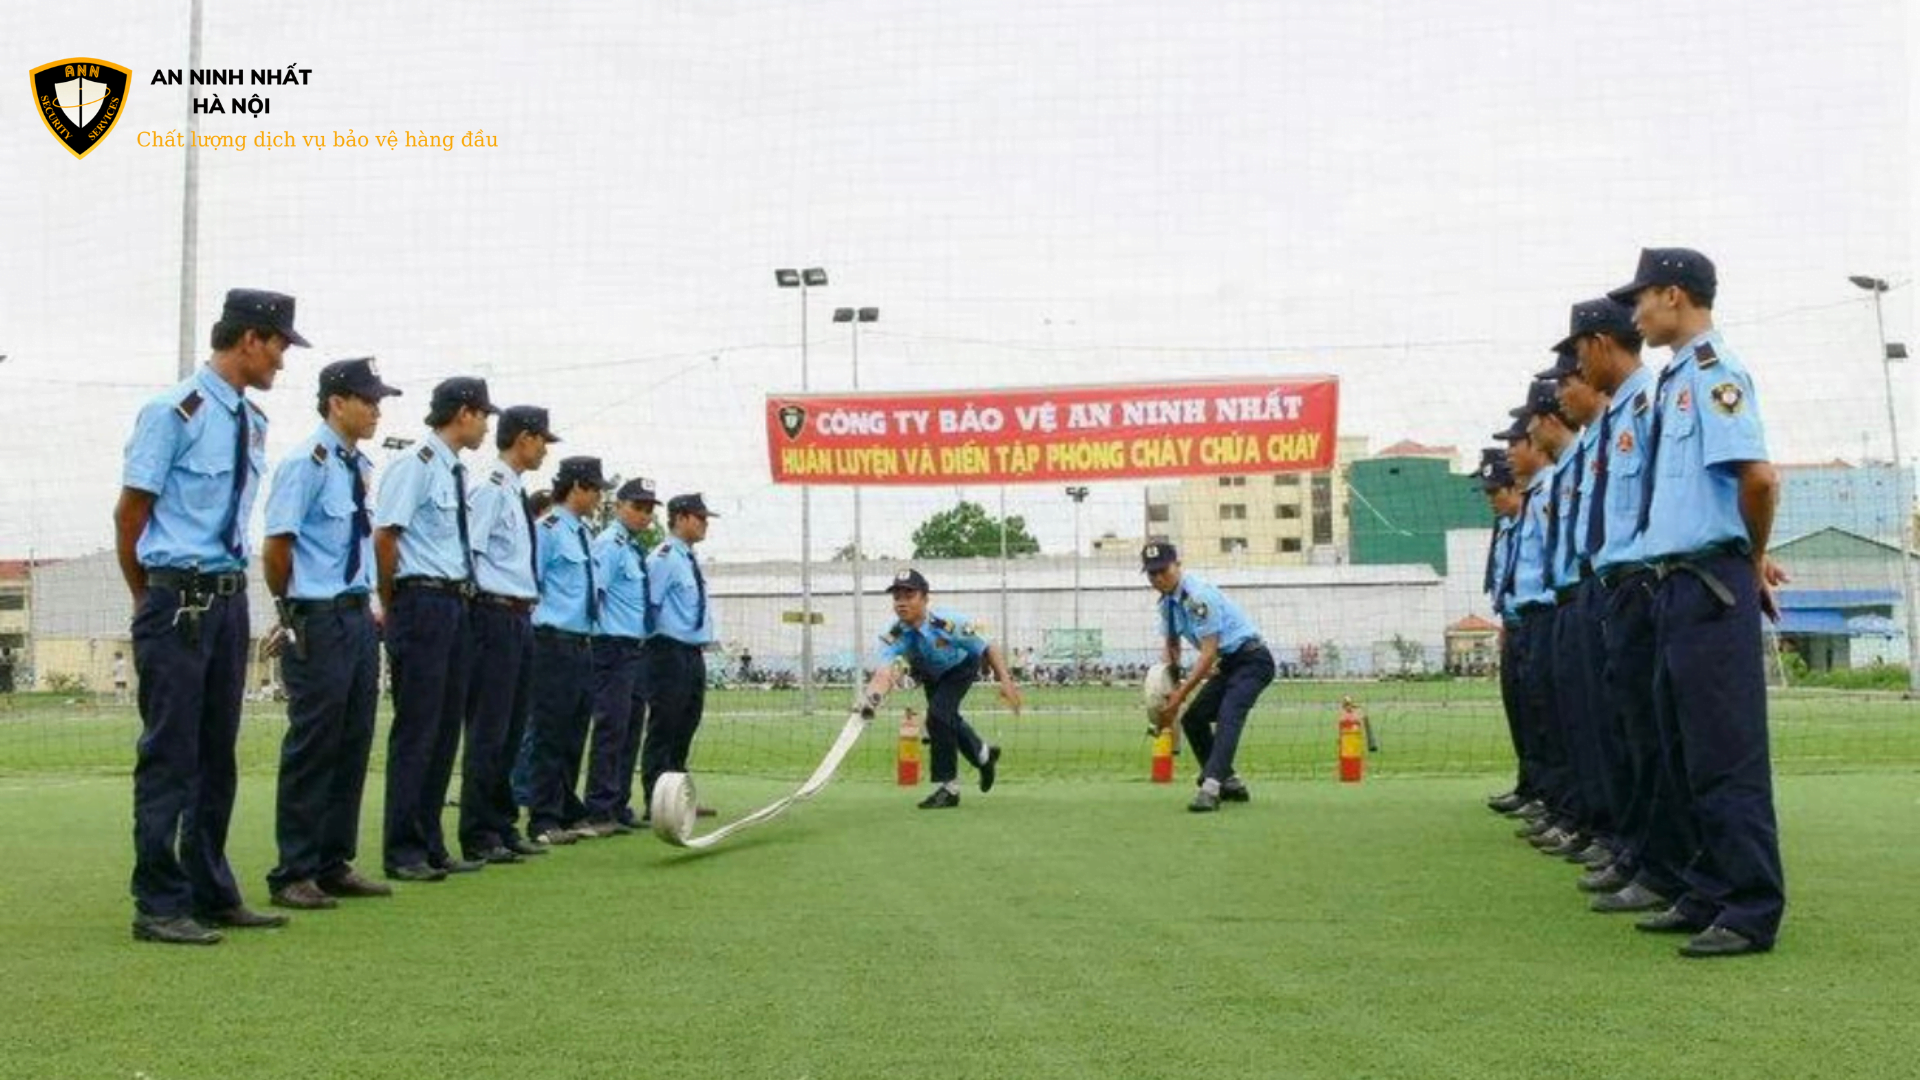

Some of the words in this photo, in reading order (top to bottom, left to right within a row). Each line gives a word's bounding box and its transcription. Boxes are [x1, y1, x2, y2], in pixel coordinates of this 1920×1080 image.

[816, 408, 886, 436] CÔNG
[893, 410, 930, 434] TY
[938, 402, 1004, 433] BẢO
[1014, 401, 1057, 433] VỆ
[1067, 402, 1113, 428] AN
[1121, 399, 1206, 426] NINH
[1214, 389, 1303, 421] NHẤT
[836, 444, 899, 480] LUYỆN
[994, 440, 1040, 477] TẬP
[1046, 437, 1124, 472] PHÒNG
[1130, 434, 1193, 468] CHÁY
